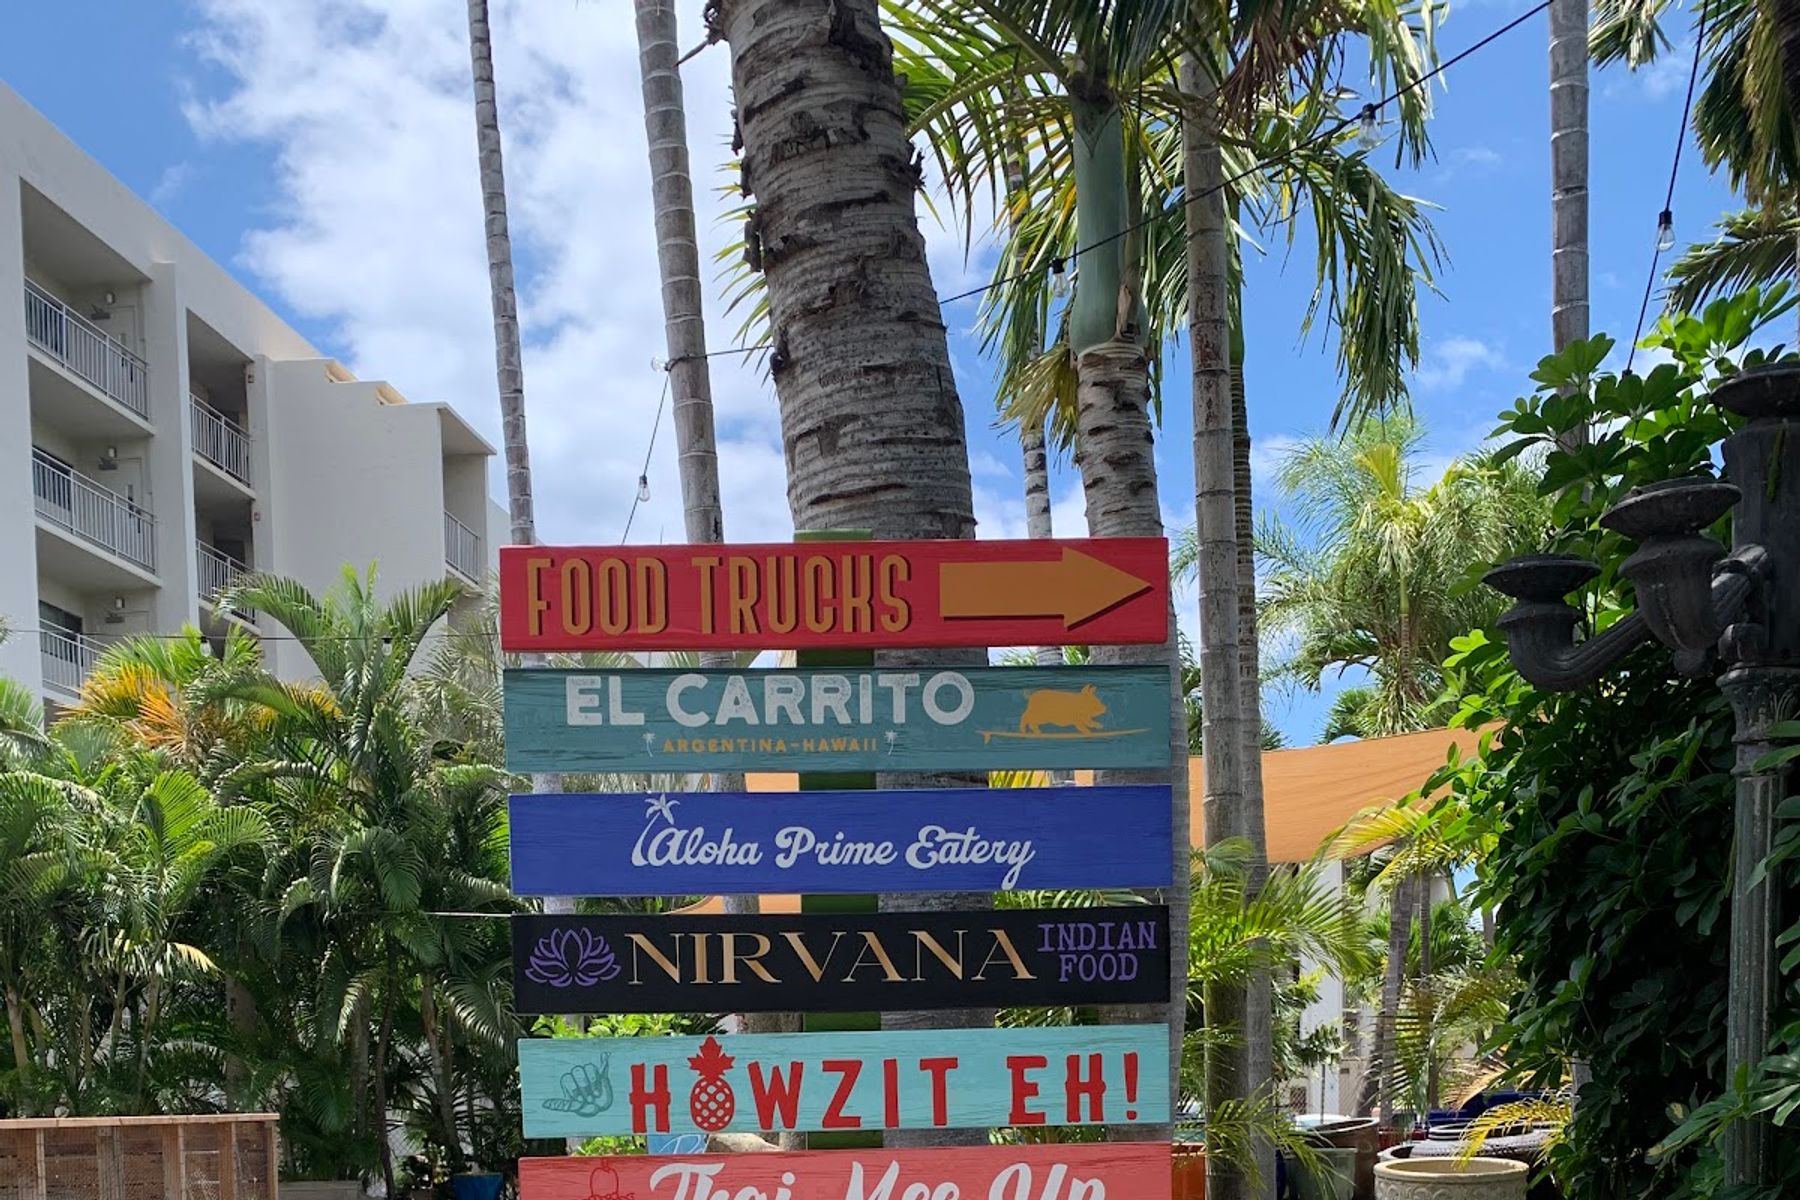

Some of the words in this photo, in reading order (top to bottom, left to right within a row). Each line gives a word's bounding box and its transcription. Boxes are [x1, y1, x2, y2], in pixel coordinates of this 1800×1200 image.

[527, 556, 668, 636] FOOD
[691, 554, 912, 634] TRUCKS
[565, 675, 644, 726] EL
[666, 671, 975, 725] CARRITO
[663, 738, 878, 753] ARGENTINA-HAWAII
[632, 820, 762, 866] Aloha
[775, 827, 897, 868] Prime
[905, 825, 1036, 890] Eatery
[624, 929, 1038, 985] NIRVANA
[1037, 921, 1156, 952] INDIAN
[1058, 953, 1138, 982] FOOD
[1007, 1052, 1139, 1125] EH!
